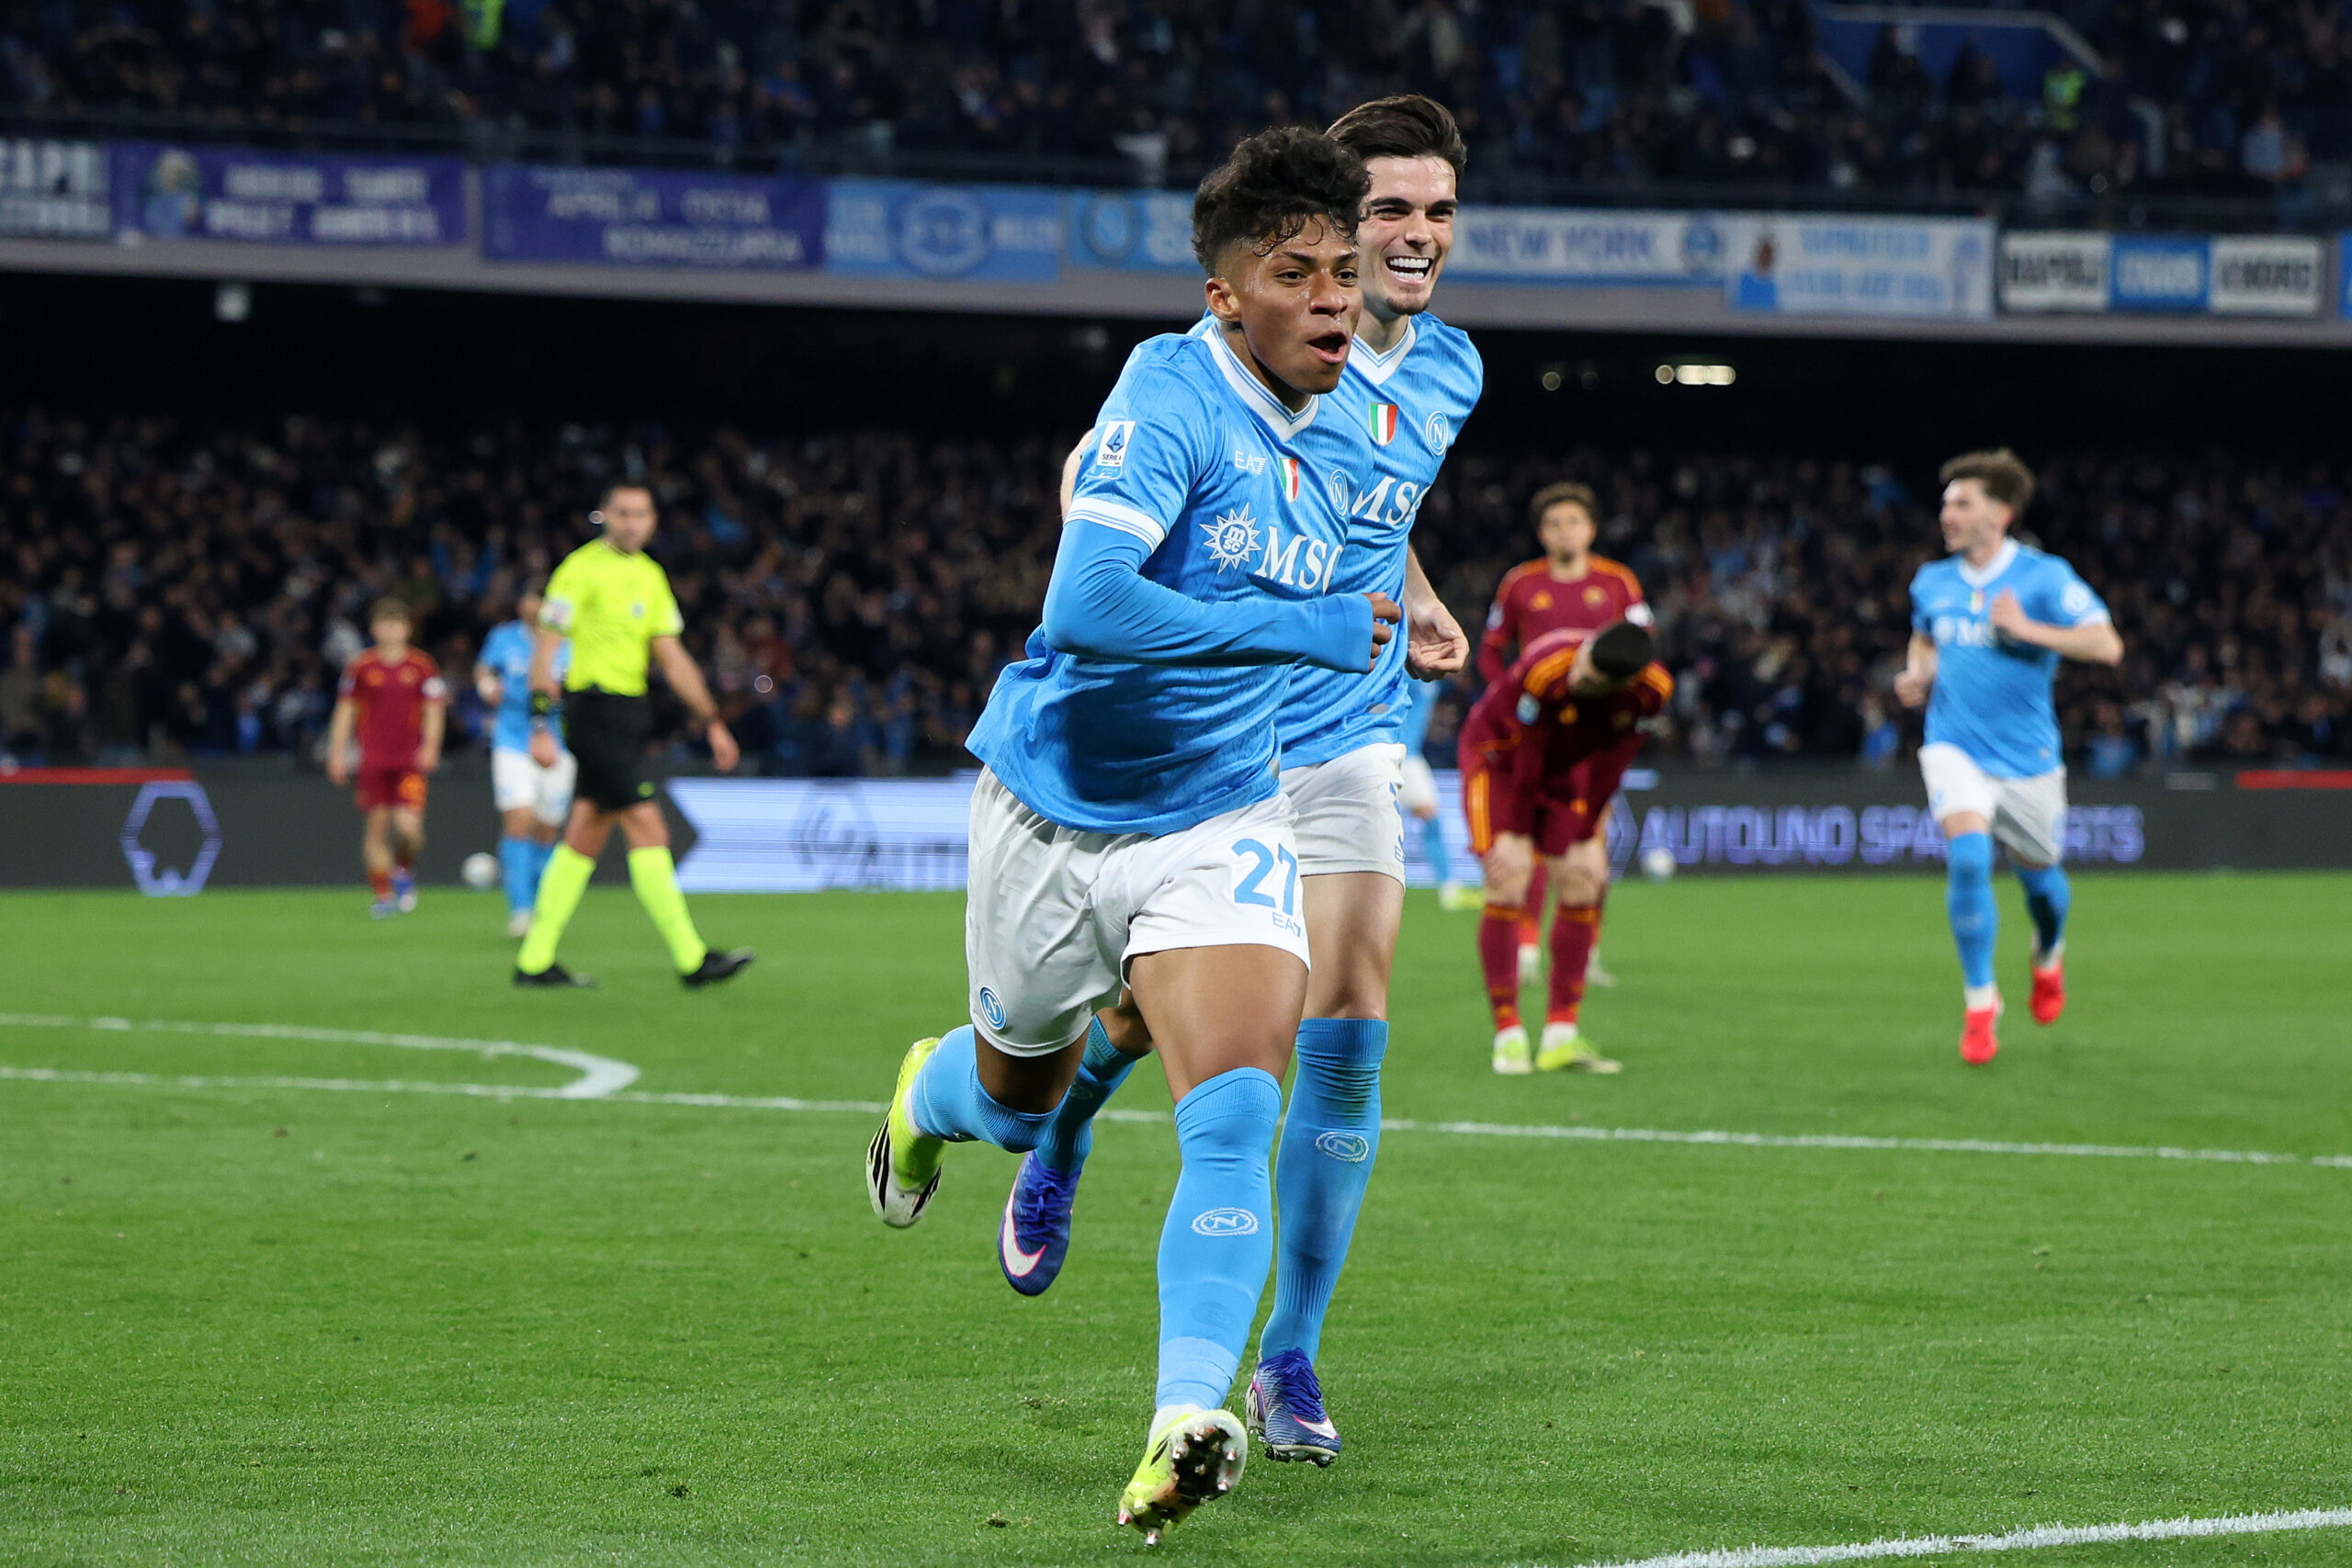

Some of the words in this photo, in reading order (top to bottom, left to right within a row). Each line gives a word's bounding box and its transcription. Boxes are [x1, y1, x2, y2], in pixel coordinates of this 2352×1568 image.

[1469, 225, 1551, 259] NEW
[1102, 453, 1118, 461] SERIE
[1234, 449, 1267, 476] EA7
